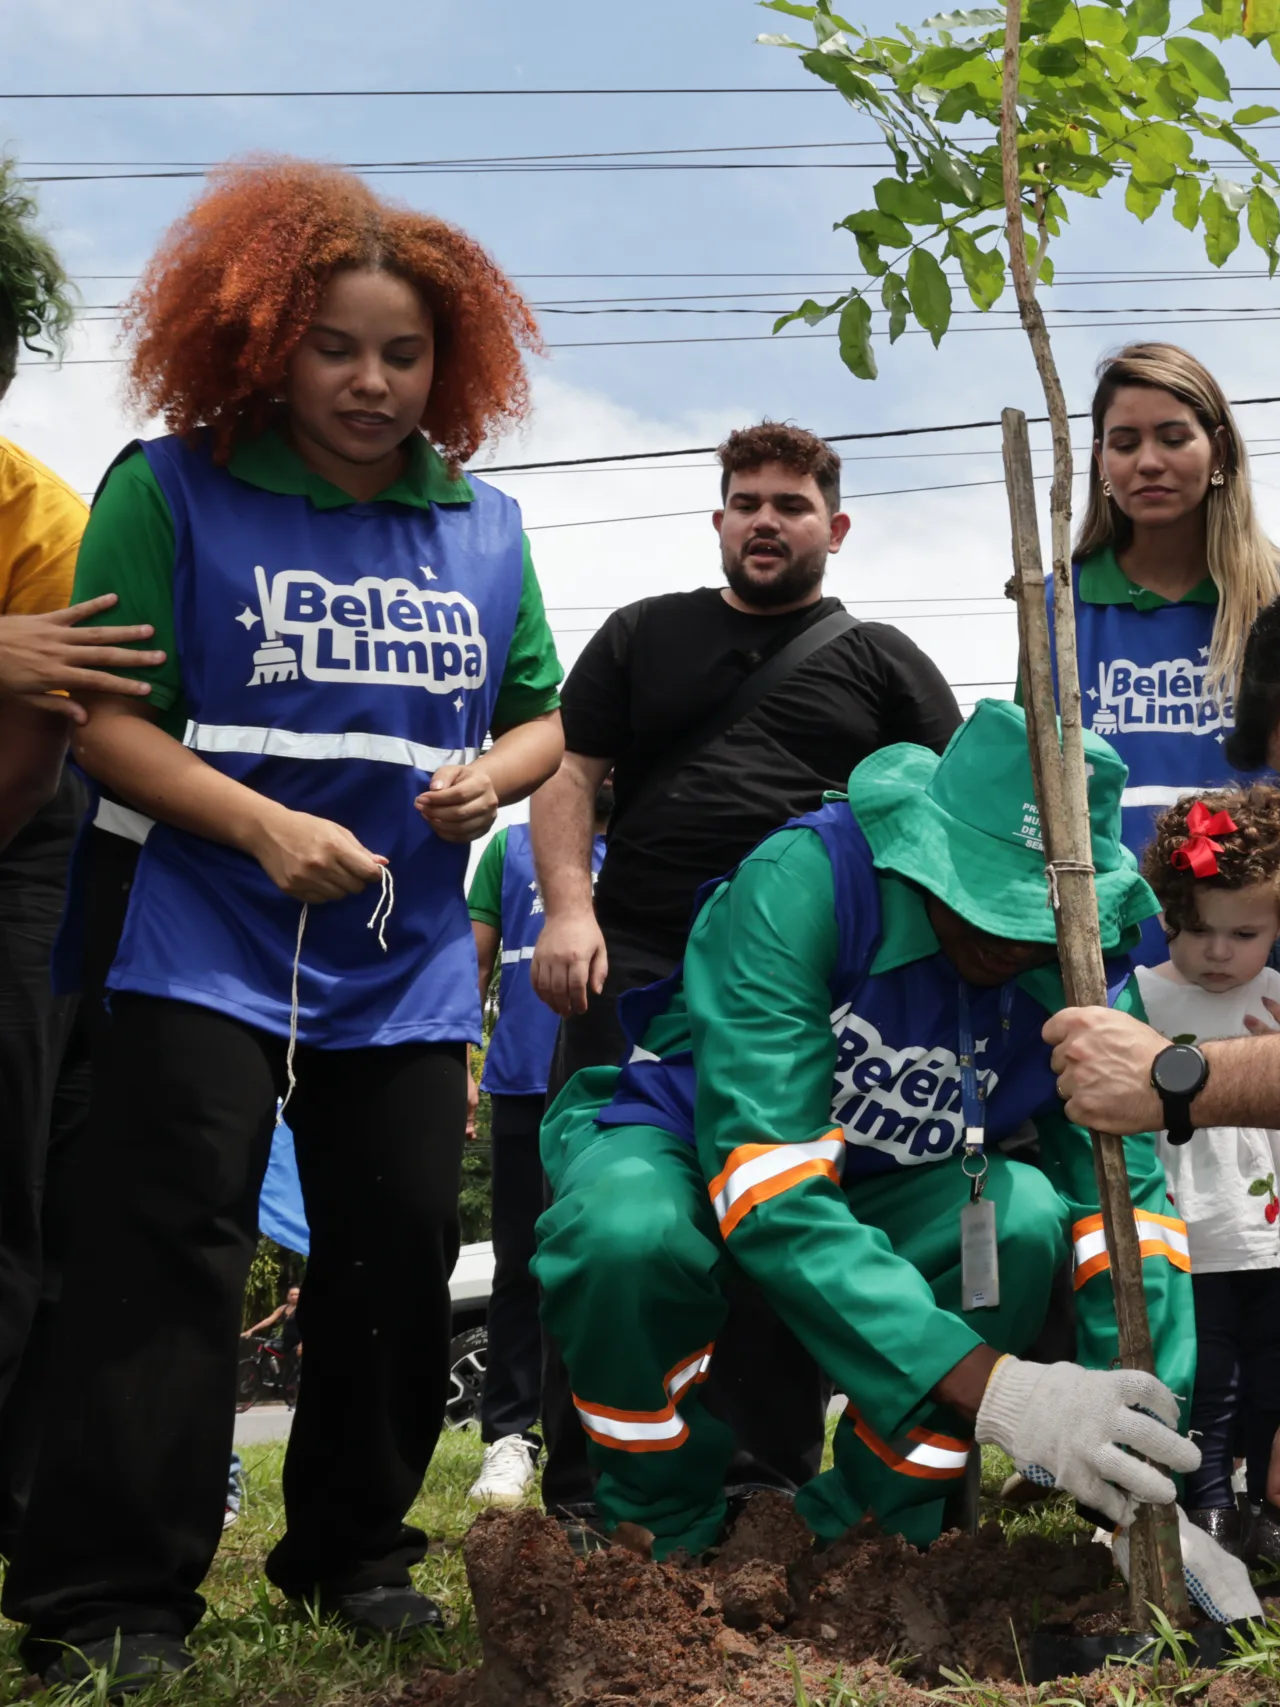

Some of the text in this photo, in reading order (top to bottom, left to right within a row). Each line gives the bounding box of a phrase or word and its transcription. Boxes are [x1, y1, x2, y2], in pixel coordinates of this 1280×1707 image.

[284, 581, 472, 637] Belém
[316, 628, 482, 681] Limpa
[1021, 825, 1037, 837] DE
[831, 1078, 966, 1158] imp
